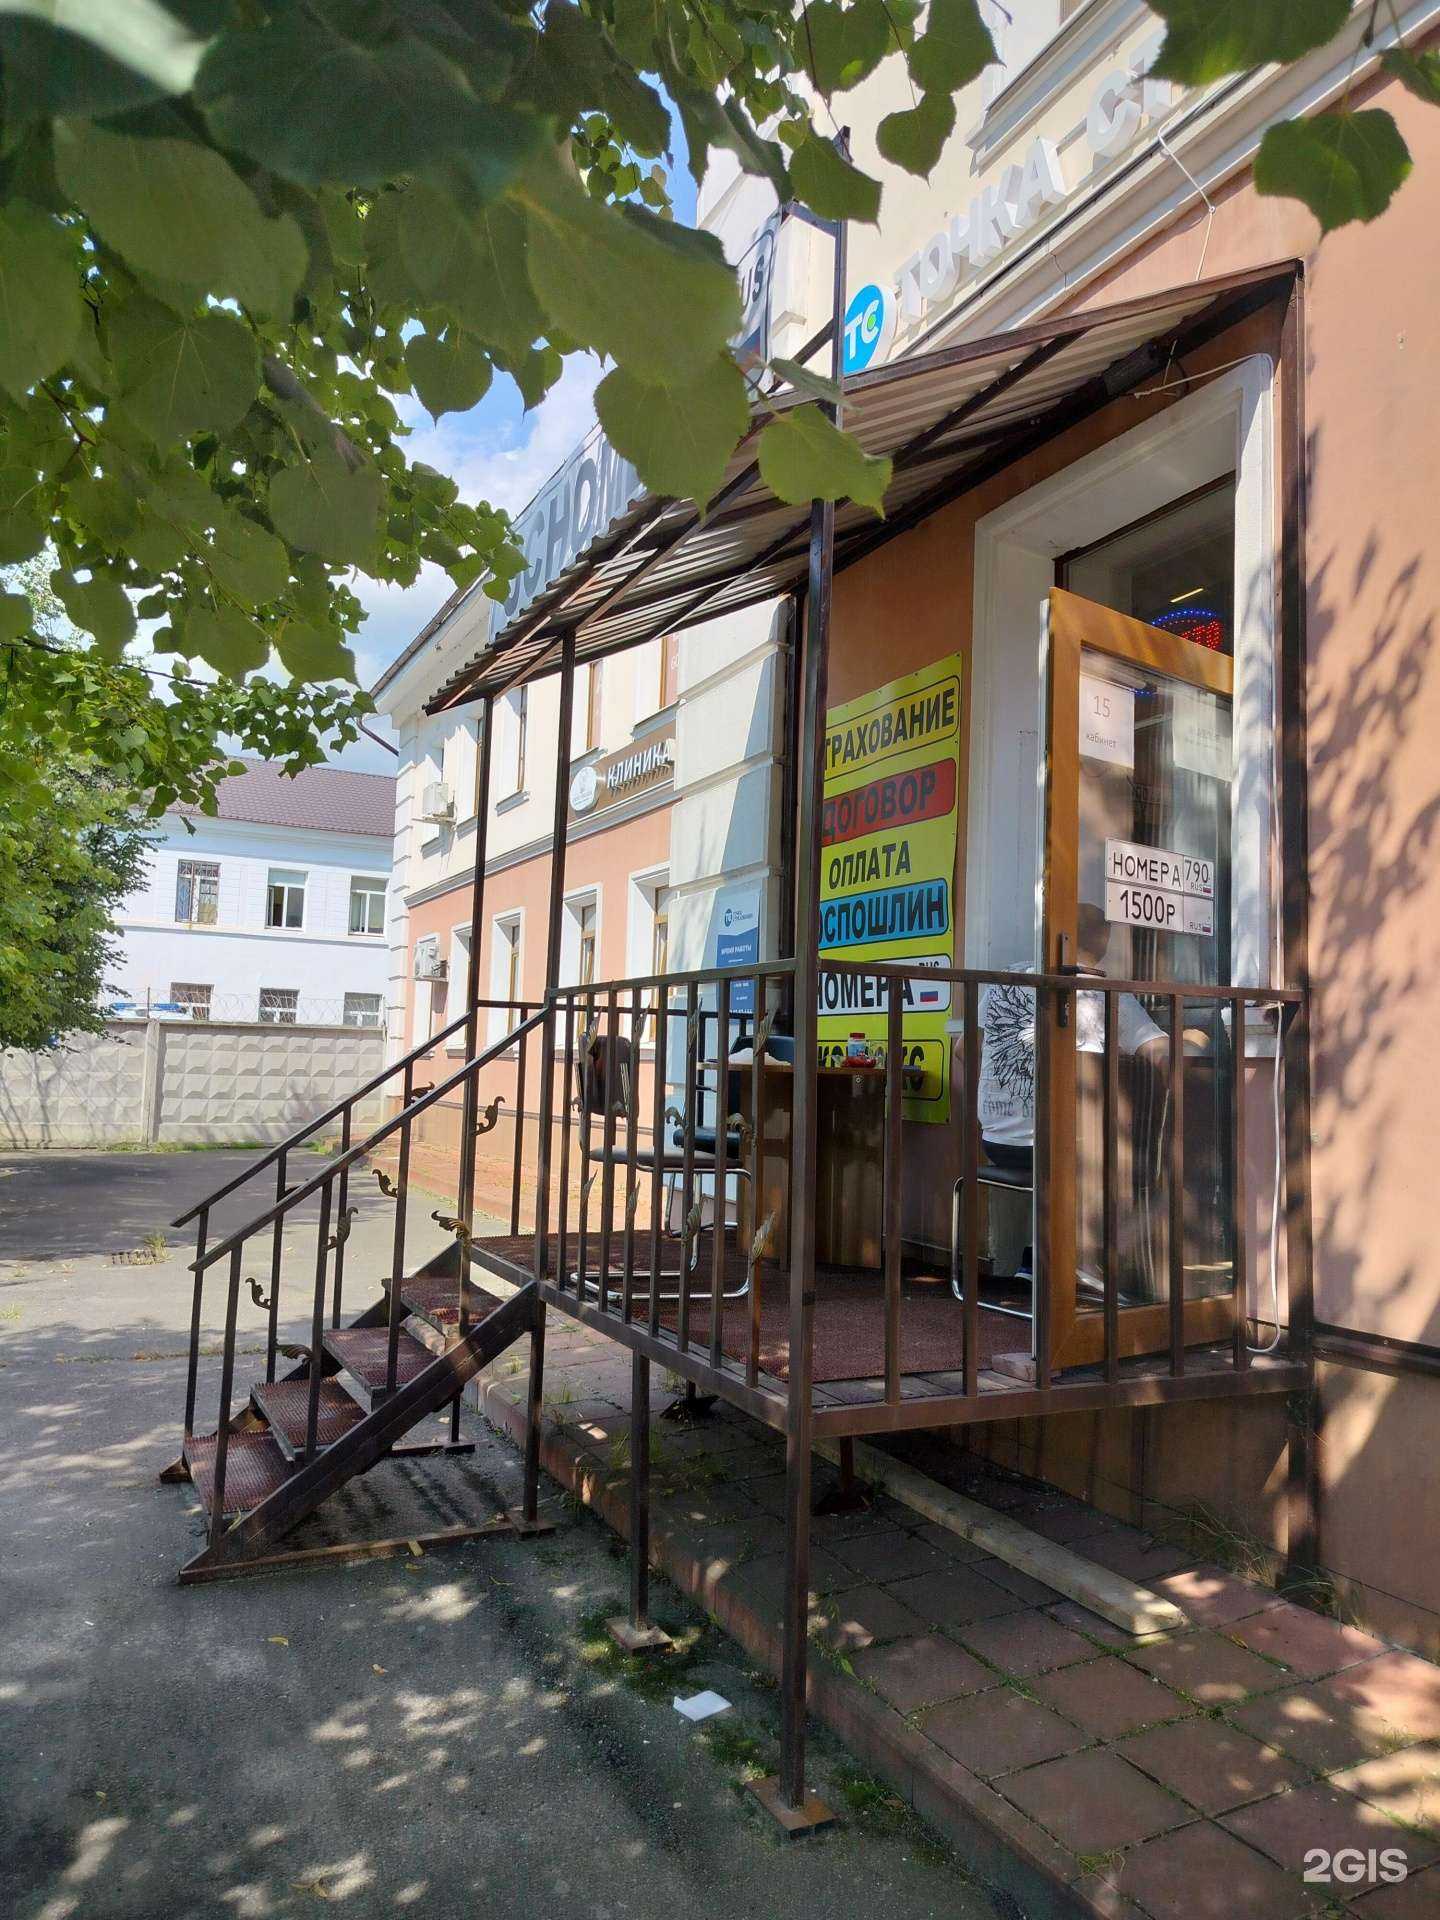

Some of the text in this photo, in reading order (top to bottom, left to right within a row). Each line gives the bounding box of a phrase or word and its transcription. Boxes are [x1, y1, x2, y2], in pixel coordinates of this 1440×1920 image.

[894, 136, 1067, 325] ТОЧКА
[1093, 695, 1111, 717] 15
[1086, 731, 1117, 748] кабинет
[607, 738, 672, 789] КЛИНИКА
[829, 840, 911, 890] ОПЛАТА
[1113, 852, 1210, 888] НОМЕРА 790
